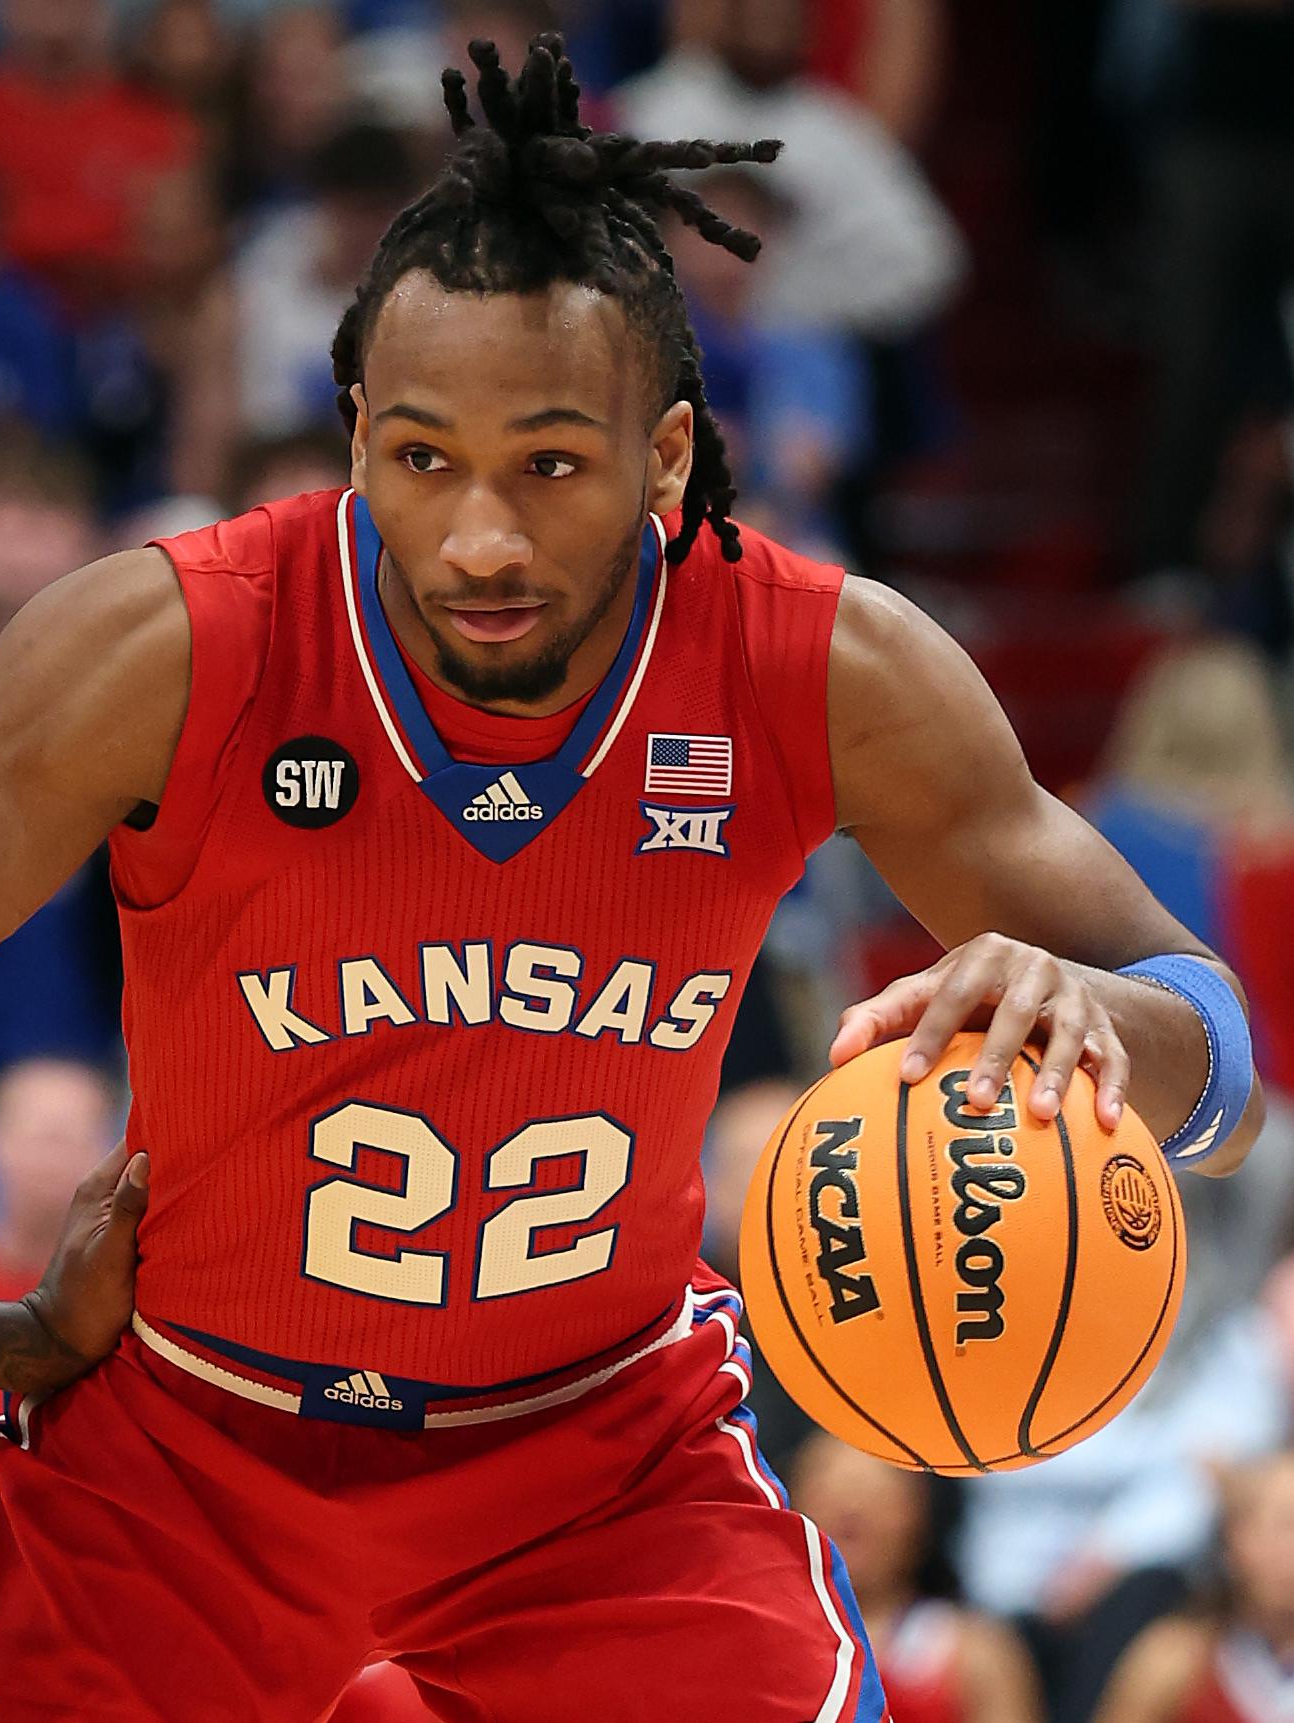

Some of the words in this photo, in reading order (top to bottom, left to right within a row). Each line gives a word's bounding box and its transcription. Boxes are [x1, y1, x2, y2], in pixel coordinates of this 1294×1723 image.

[274, 759, 346, 809] SW
[463, 802, 544, 822] adidas
[639, 806, 731, 855] XII
[236, 940, 733, 1053] KANSAS
[301, 1098, 637, 1308] 22
[809, 1116, 882, 1325] NCAA
[931, 1185, 942, 1226] GAME
[939, 1069, 1028, 1346] Wilson
[934, 1231, 944, 1267] BALL
[805, 1272, 825, 1327] BALL
[323, 1384, 404, 1411] adidas
